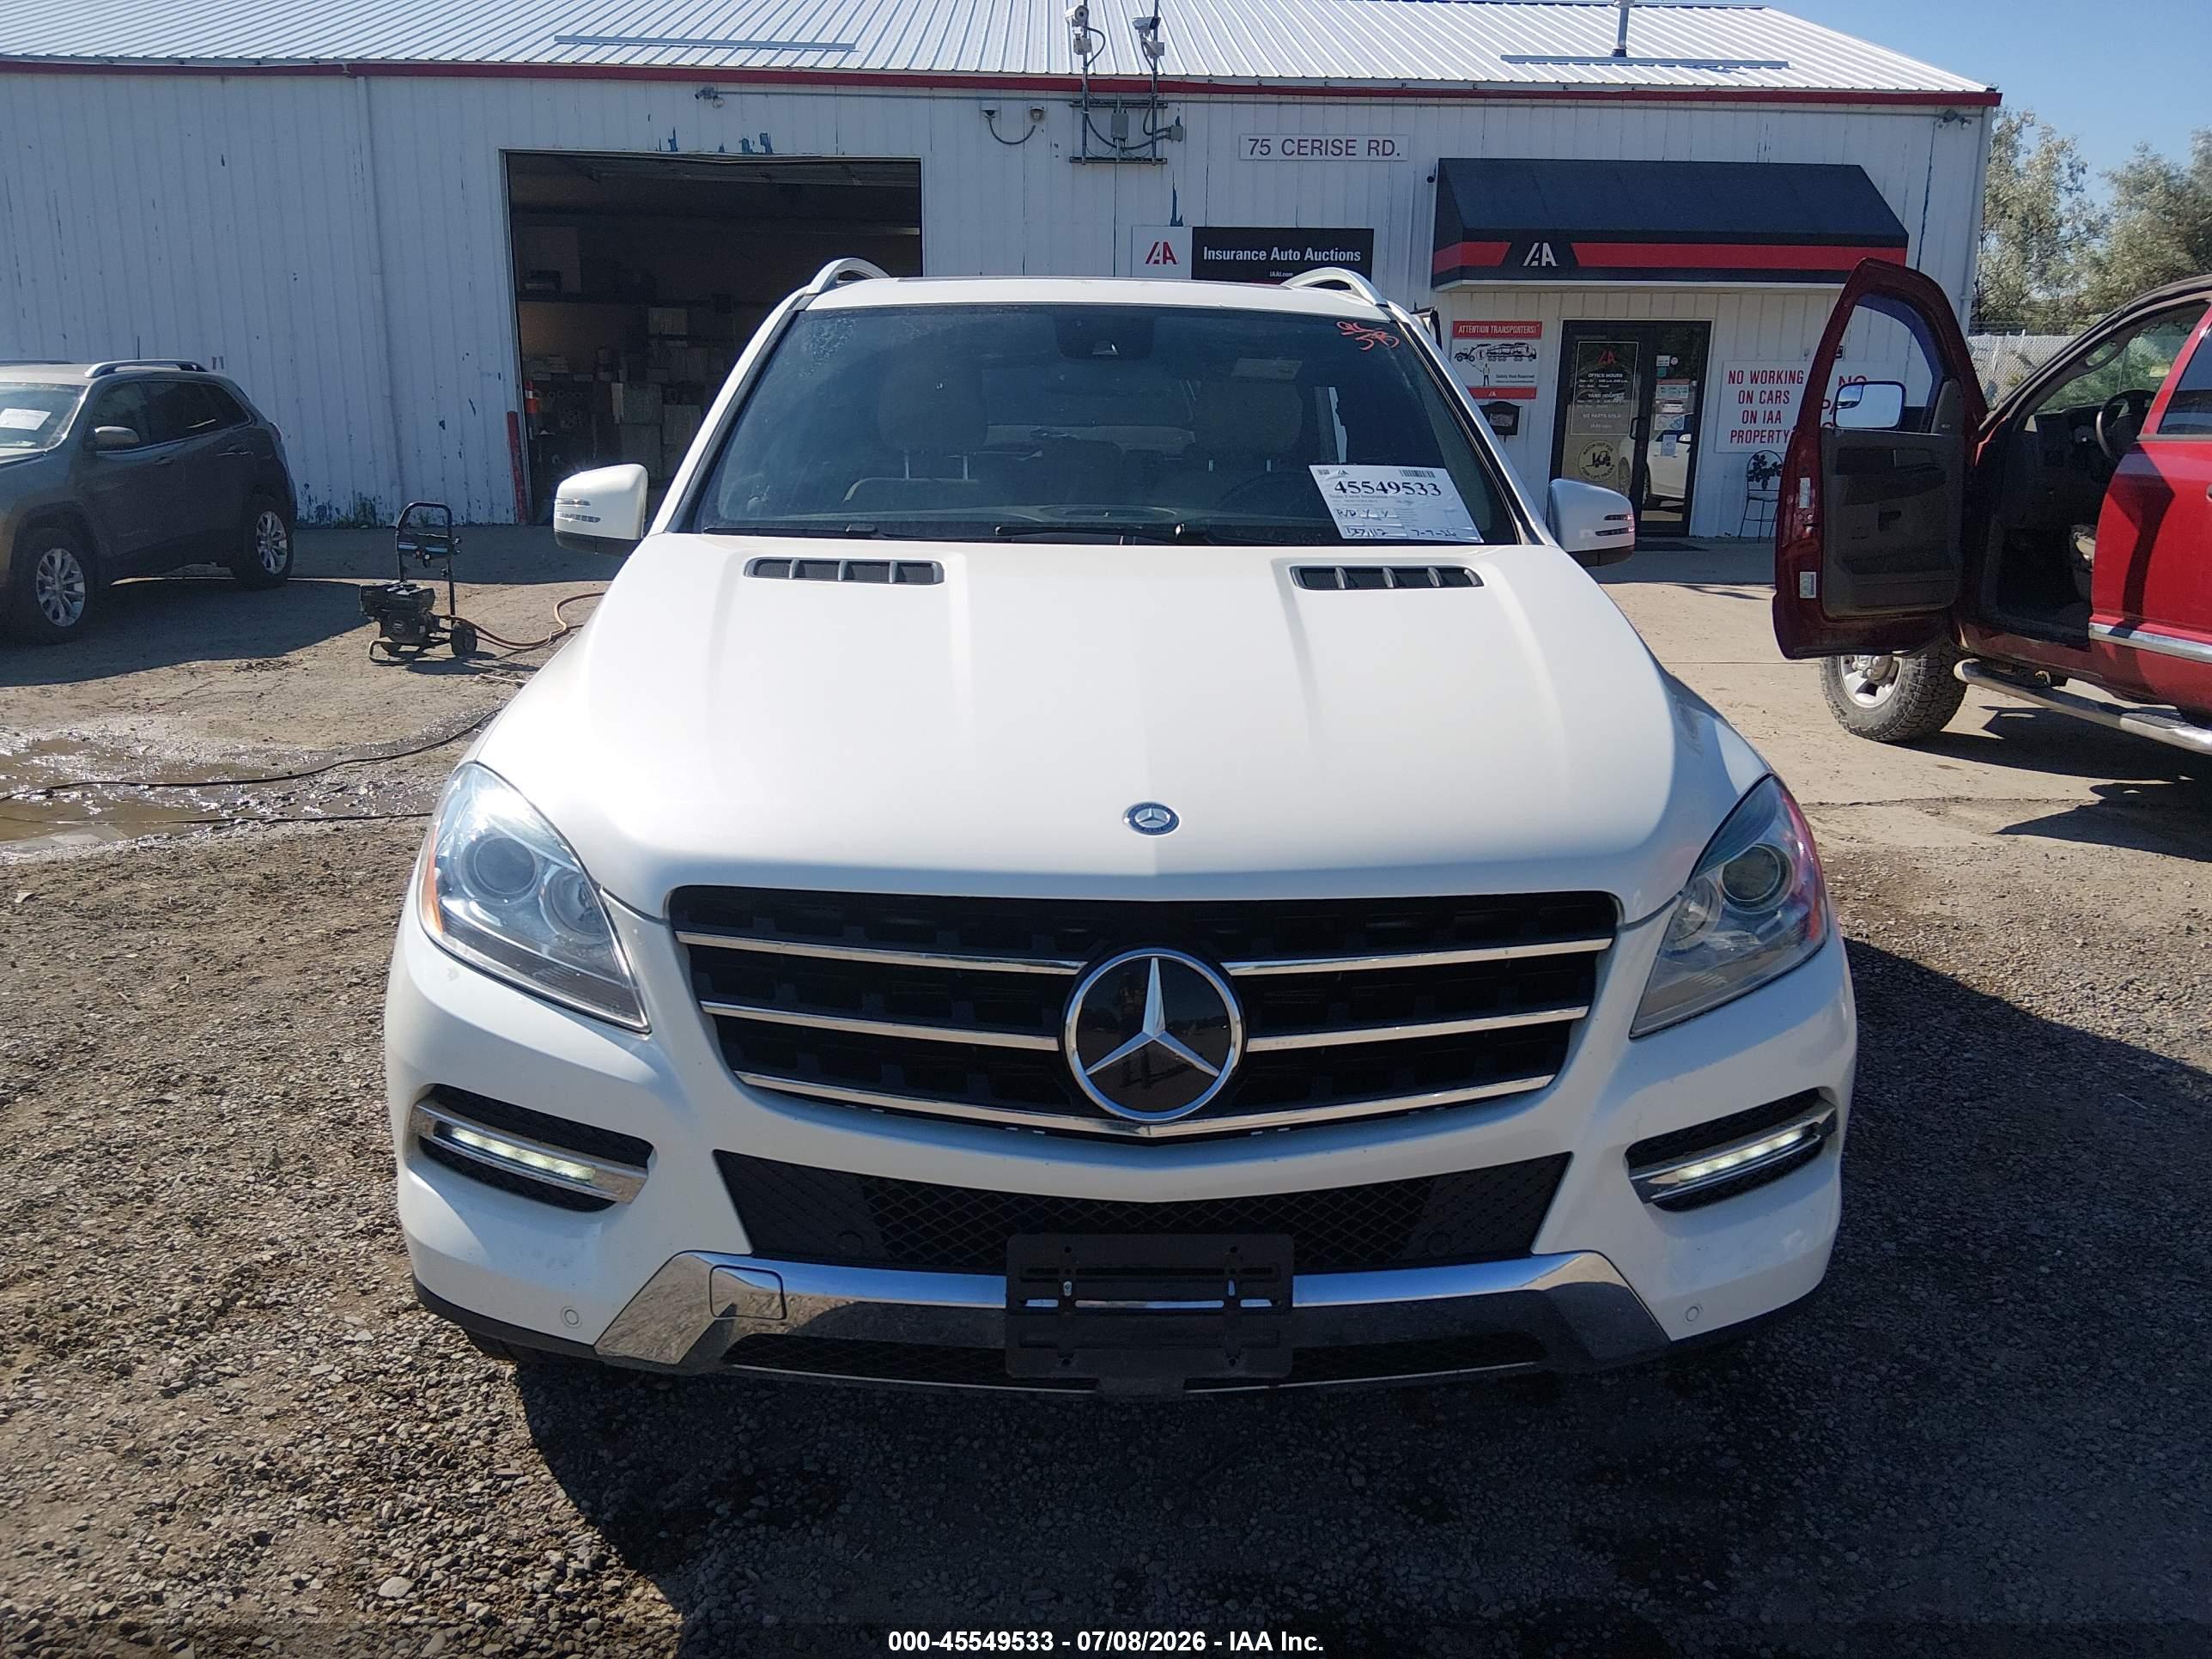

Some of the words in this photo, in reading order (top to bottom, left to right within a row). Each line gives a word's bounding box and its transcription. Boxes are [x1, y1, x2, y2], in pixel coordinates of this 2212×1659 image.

[1248, 138, 1272, 156] 75
[1280, 138, 1358, 156] CERISE
[1367, 139, 1401, 156] RD.
[1203, 246, 1267, 262] Insurance
[1270, 246, 1301, 261] Auto
[1304, 246, 1362, 262] Auctions
[1458, 325, 1490, 334] ATTENTION
[1491, 325, 1537, 334] TRANSPORTERS!
[1728, 370, 1744, 385] NO
[1750, 370, 1804, 385] WORKING
[1738, 390, 1753, 404] ON
[1759, 390, 1790, 404] CARS
[1741, 410, 1758, 424] ON
[1763, 410, 1782, 424] IAA
[1730, 429, 1789, 444] PROPERTY
[1334, 480, 1442, 496] 45549533
